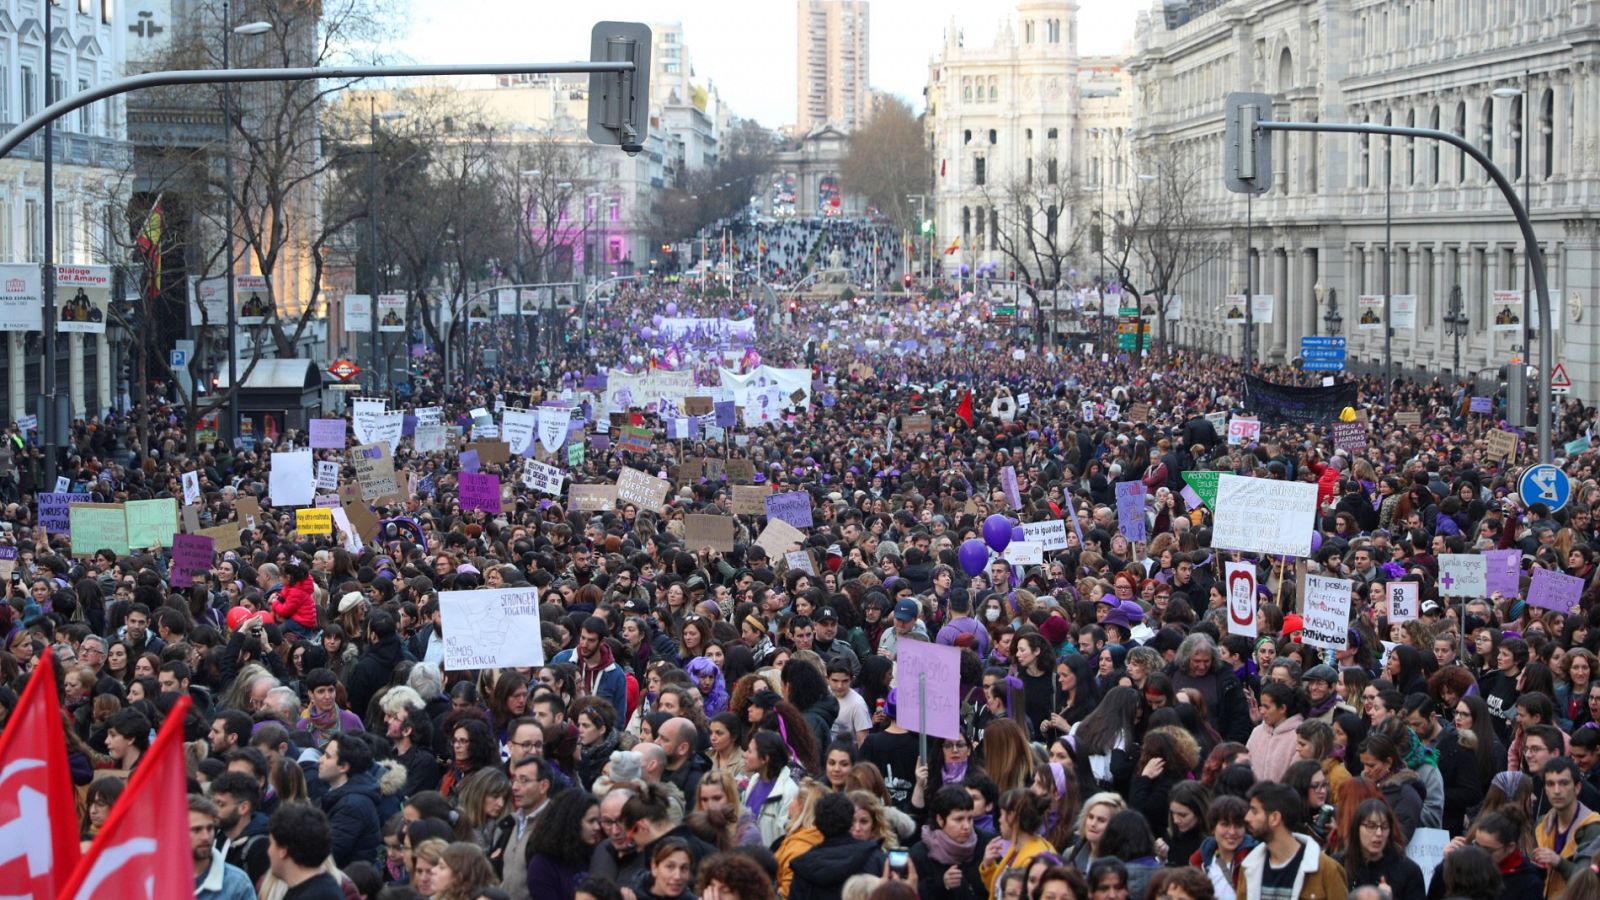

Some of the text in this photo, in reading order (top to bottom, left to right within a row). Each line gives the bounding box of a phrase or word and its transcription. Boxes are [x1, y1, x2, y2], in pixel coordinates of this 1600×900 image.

[59, 267, 90, 276] Diálogo
[74, 275, 106, 283] Amargo
[173, 352, 183, 365] P
[624, 470, 652, 484] SOMOS
[620, 479, 656, 497] FUERTES
[40, 494, 52, 503] NO
[55, 494, 71, 504] HAY
[618, 488, 641, 503] NOKIA
[766, 496, 776, 506] EL
[40, 508, 61, 517] VIRUS
[40, 520, 70, 530] PATRIA
[1308, 578, 1350, 592] Mi postura
[501, 592, 536, 606] STRONGER
[504, 605, 536, 616] TOGETHER
[1322, 606, 1346, 616] arriba
[1393, 608, 1409, 616] DAD
[1312, 617, 1335, 631] ABAJO
[446, 636, 456, 646] NO
[446, 645, 473, 657] SOMOS
[446, 655, 497, 668] COMPETENCIA
